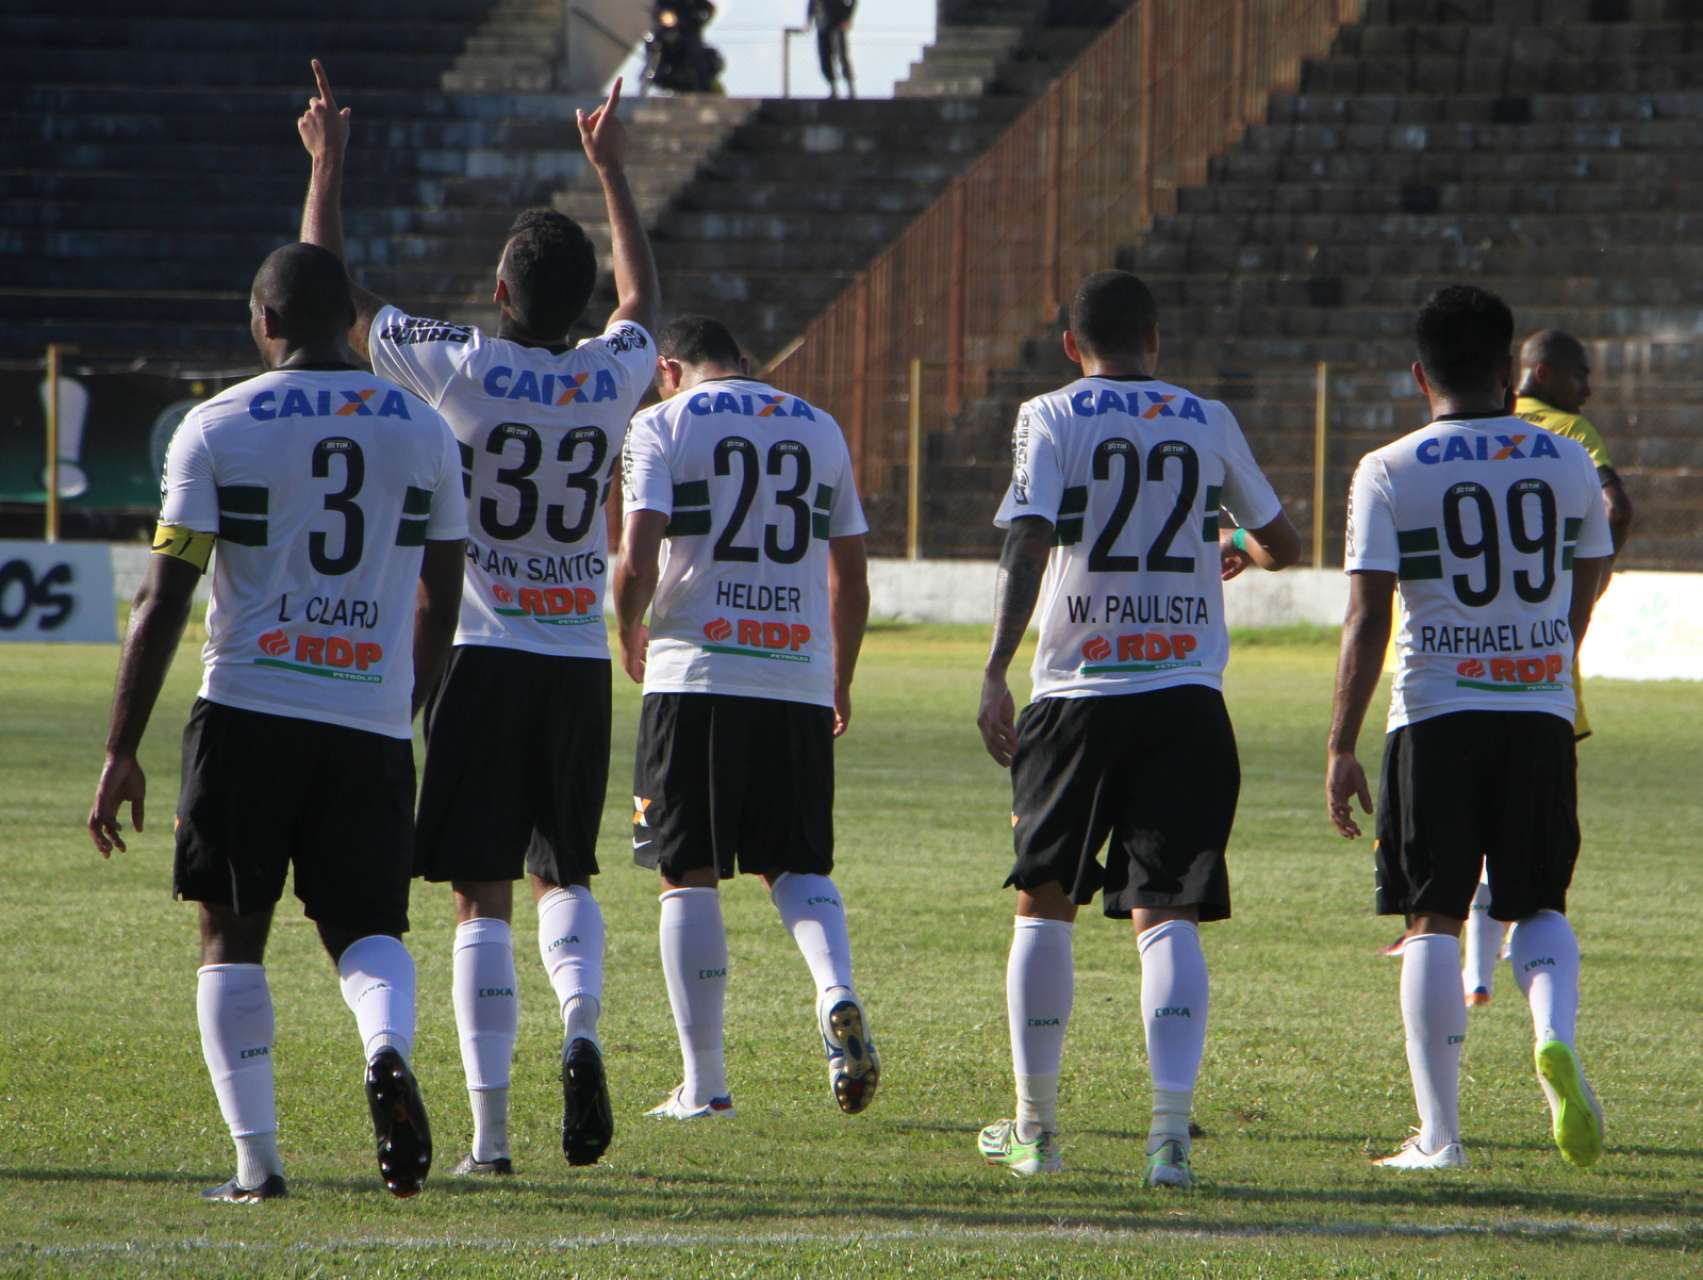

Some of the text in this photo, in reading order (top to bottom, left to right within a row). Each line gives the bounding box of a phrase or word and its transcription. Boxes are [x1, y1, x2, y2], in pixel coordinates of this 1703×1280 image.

[483, 366, 618, 406] CAIXA
[248, 389, 411, 421] CAIXA
[688, 392, 815, 422] CAIXA
[1071, 390, 1207, 424] CAIXA
[1416, 434, 1560, 465] CAIXA
[480, 422, 607, 543] 33
[309, 436, 365, 575] 3
[713, 436, 811, 564] 23
[1088, 437, 1200, 573] 22
[1443, 478, 1557, 607] 99
[517, 587, 597, 616] RDP
[716, 580, 800, 613] HELDER
[1067, 595, 1209, 624] W. PAULISTA
[737, 619, 811, 651] RDP
[1117, 632, 1197, 662] RDP
[295, 634, 383, 670] RDP
[1490, 654, 1563, 683] RDP
